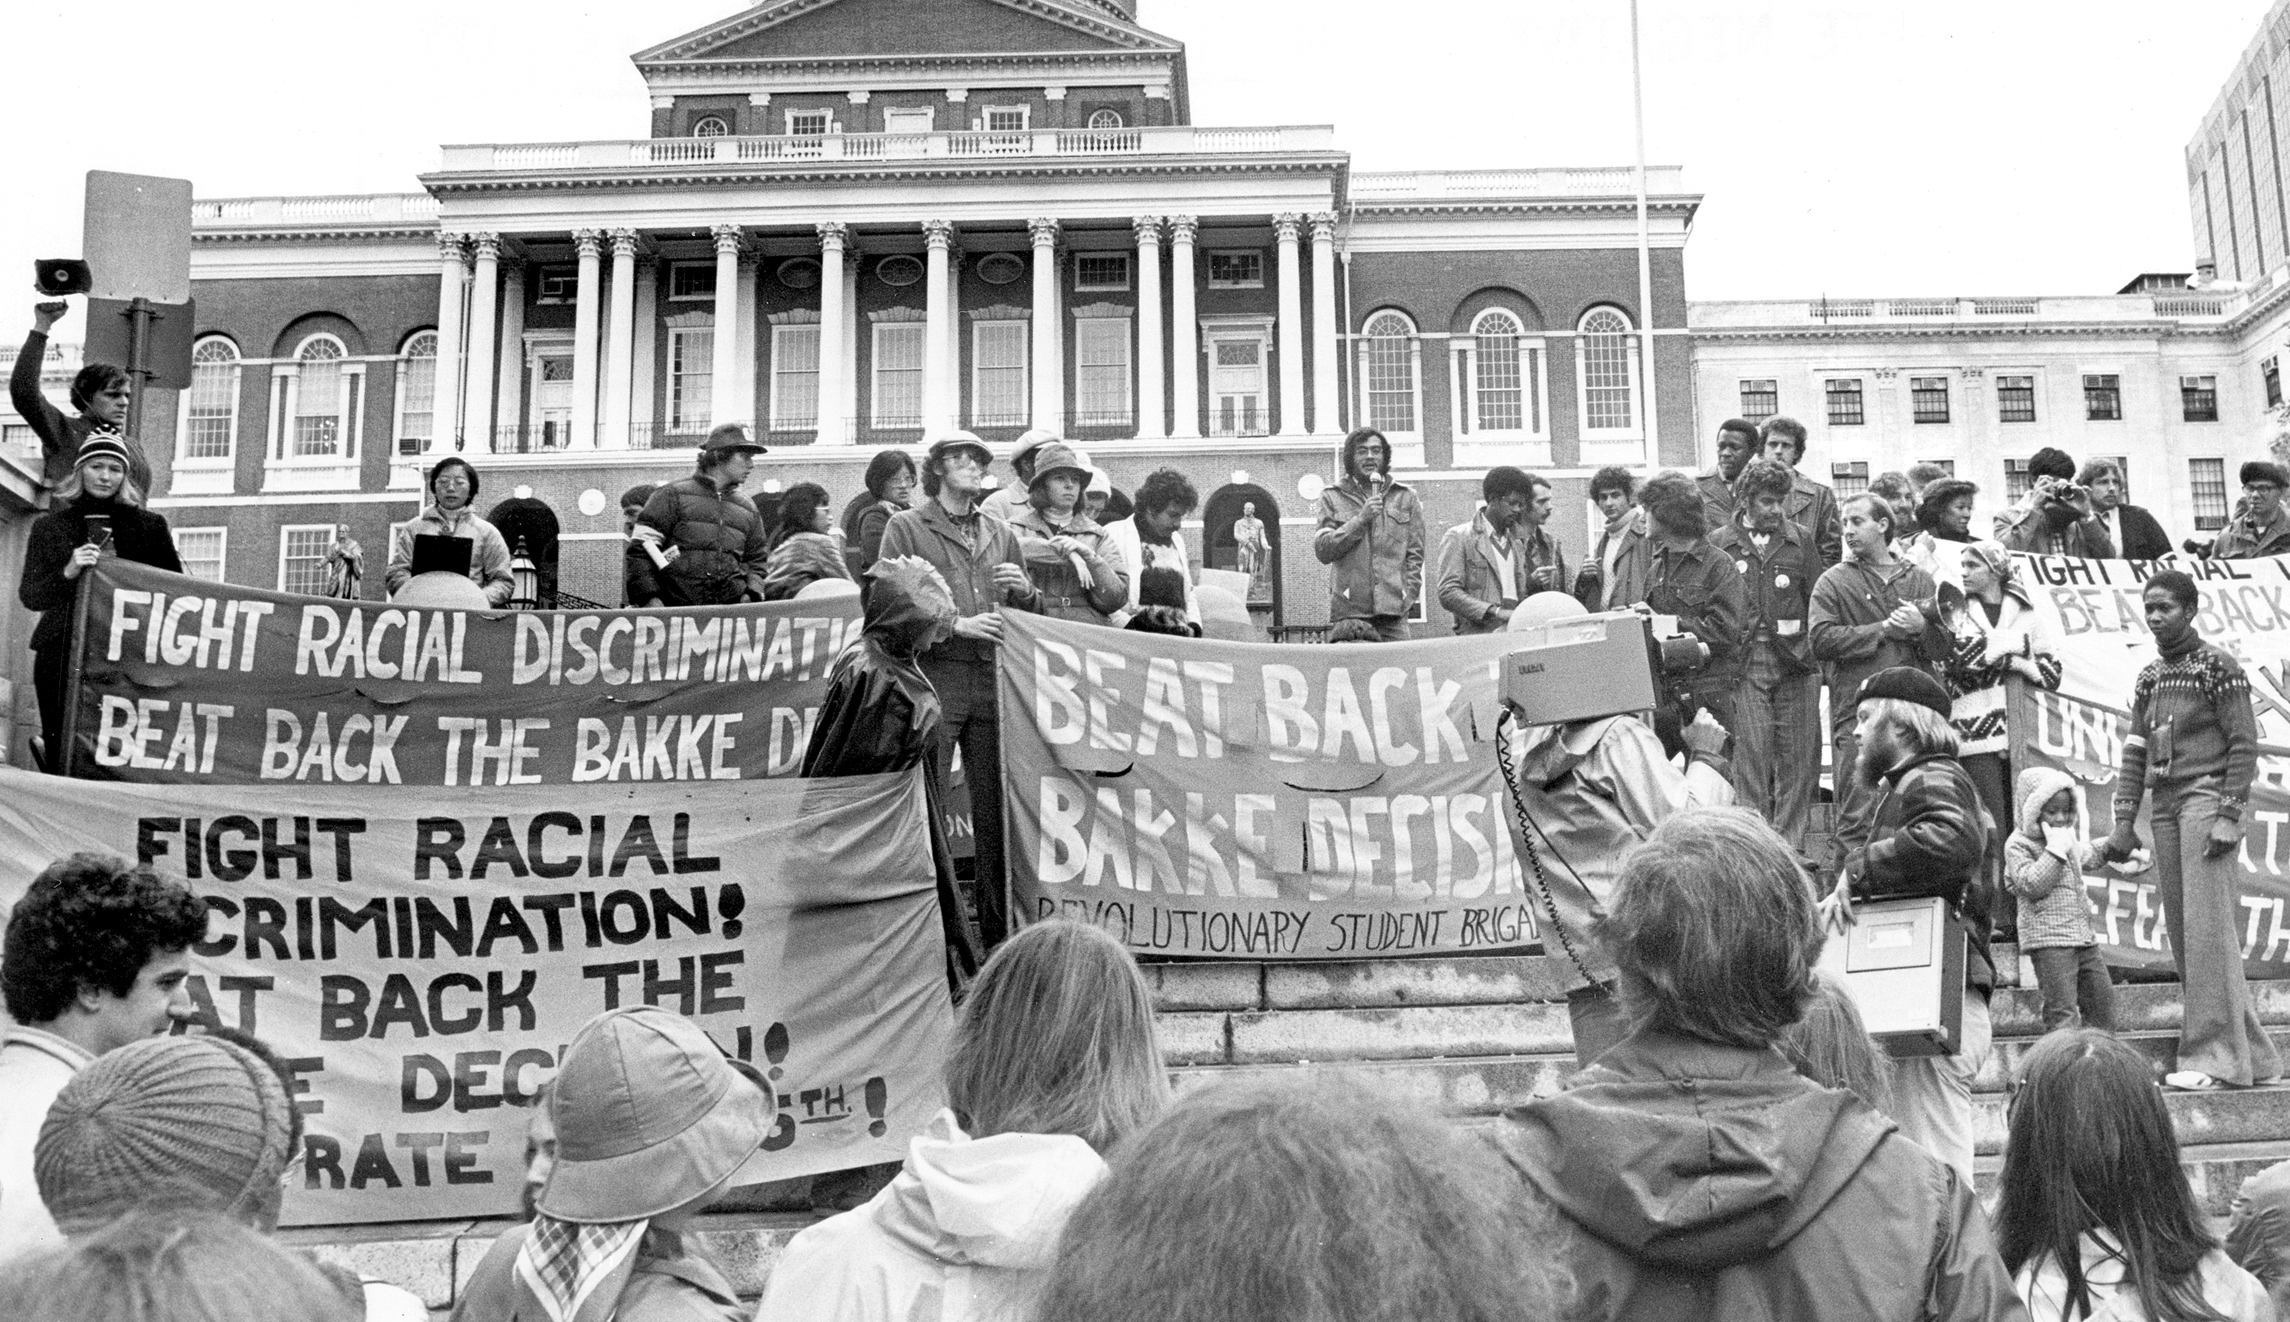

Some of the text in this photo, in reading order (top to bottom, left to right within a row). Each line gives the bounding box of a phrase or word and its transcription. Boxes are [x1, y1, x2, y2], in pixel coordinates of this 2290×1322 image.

[108, 588, 274, 672] FIGHT
[295, 605, 482, 684] RACIAL
[95, 695, 234, 774] BEAT
[261, 709, 408, 785] BACK
[437, 716, 550, 786] THE
[572, 713, 743, 783] BAKKE
[1034, 638, 1469, 767] BEAT BACK
[137, 812, 720, 882] FIGHT RACIAL
[1037, 775, 1525, 900] BAKKE DECISI
[1327, 911, 1448, 951] STUDENT
[1459, 904, 1541, 947] BRIGA
[320, 970, 538, 1042] BACK
[582, 951, 746, 1015] THE
